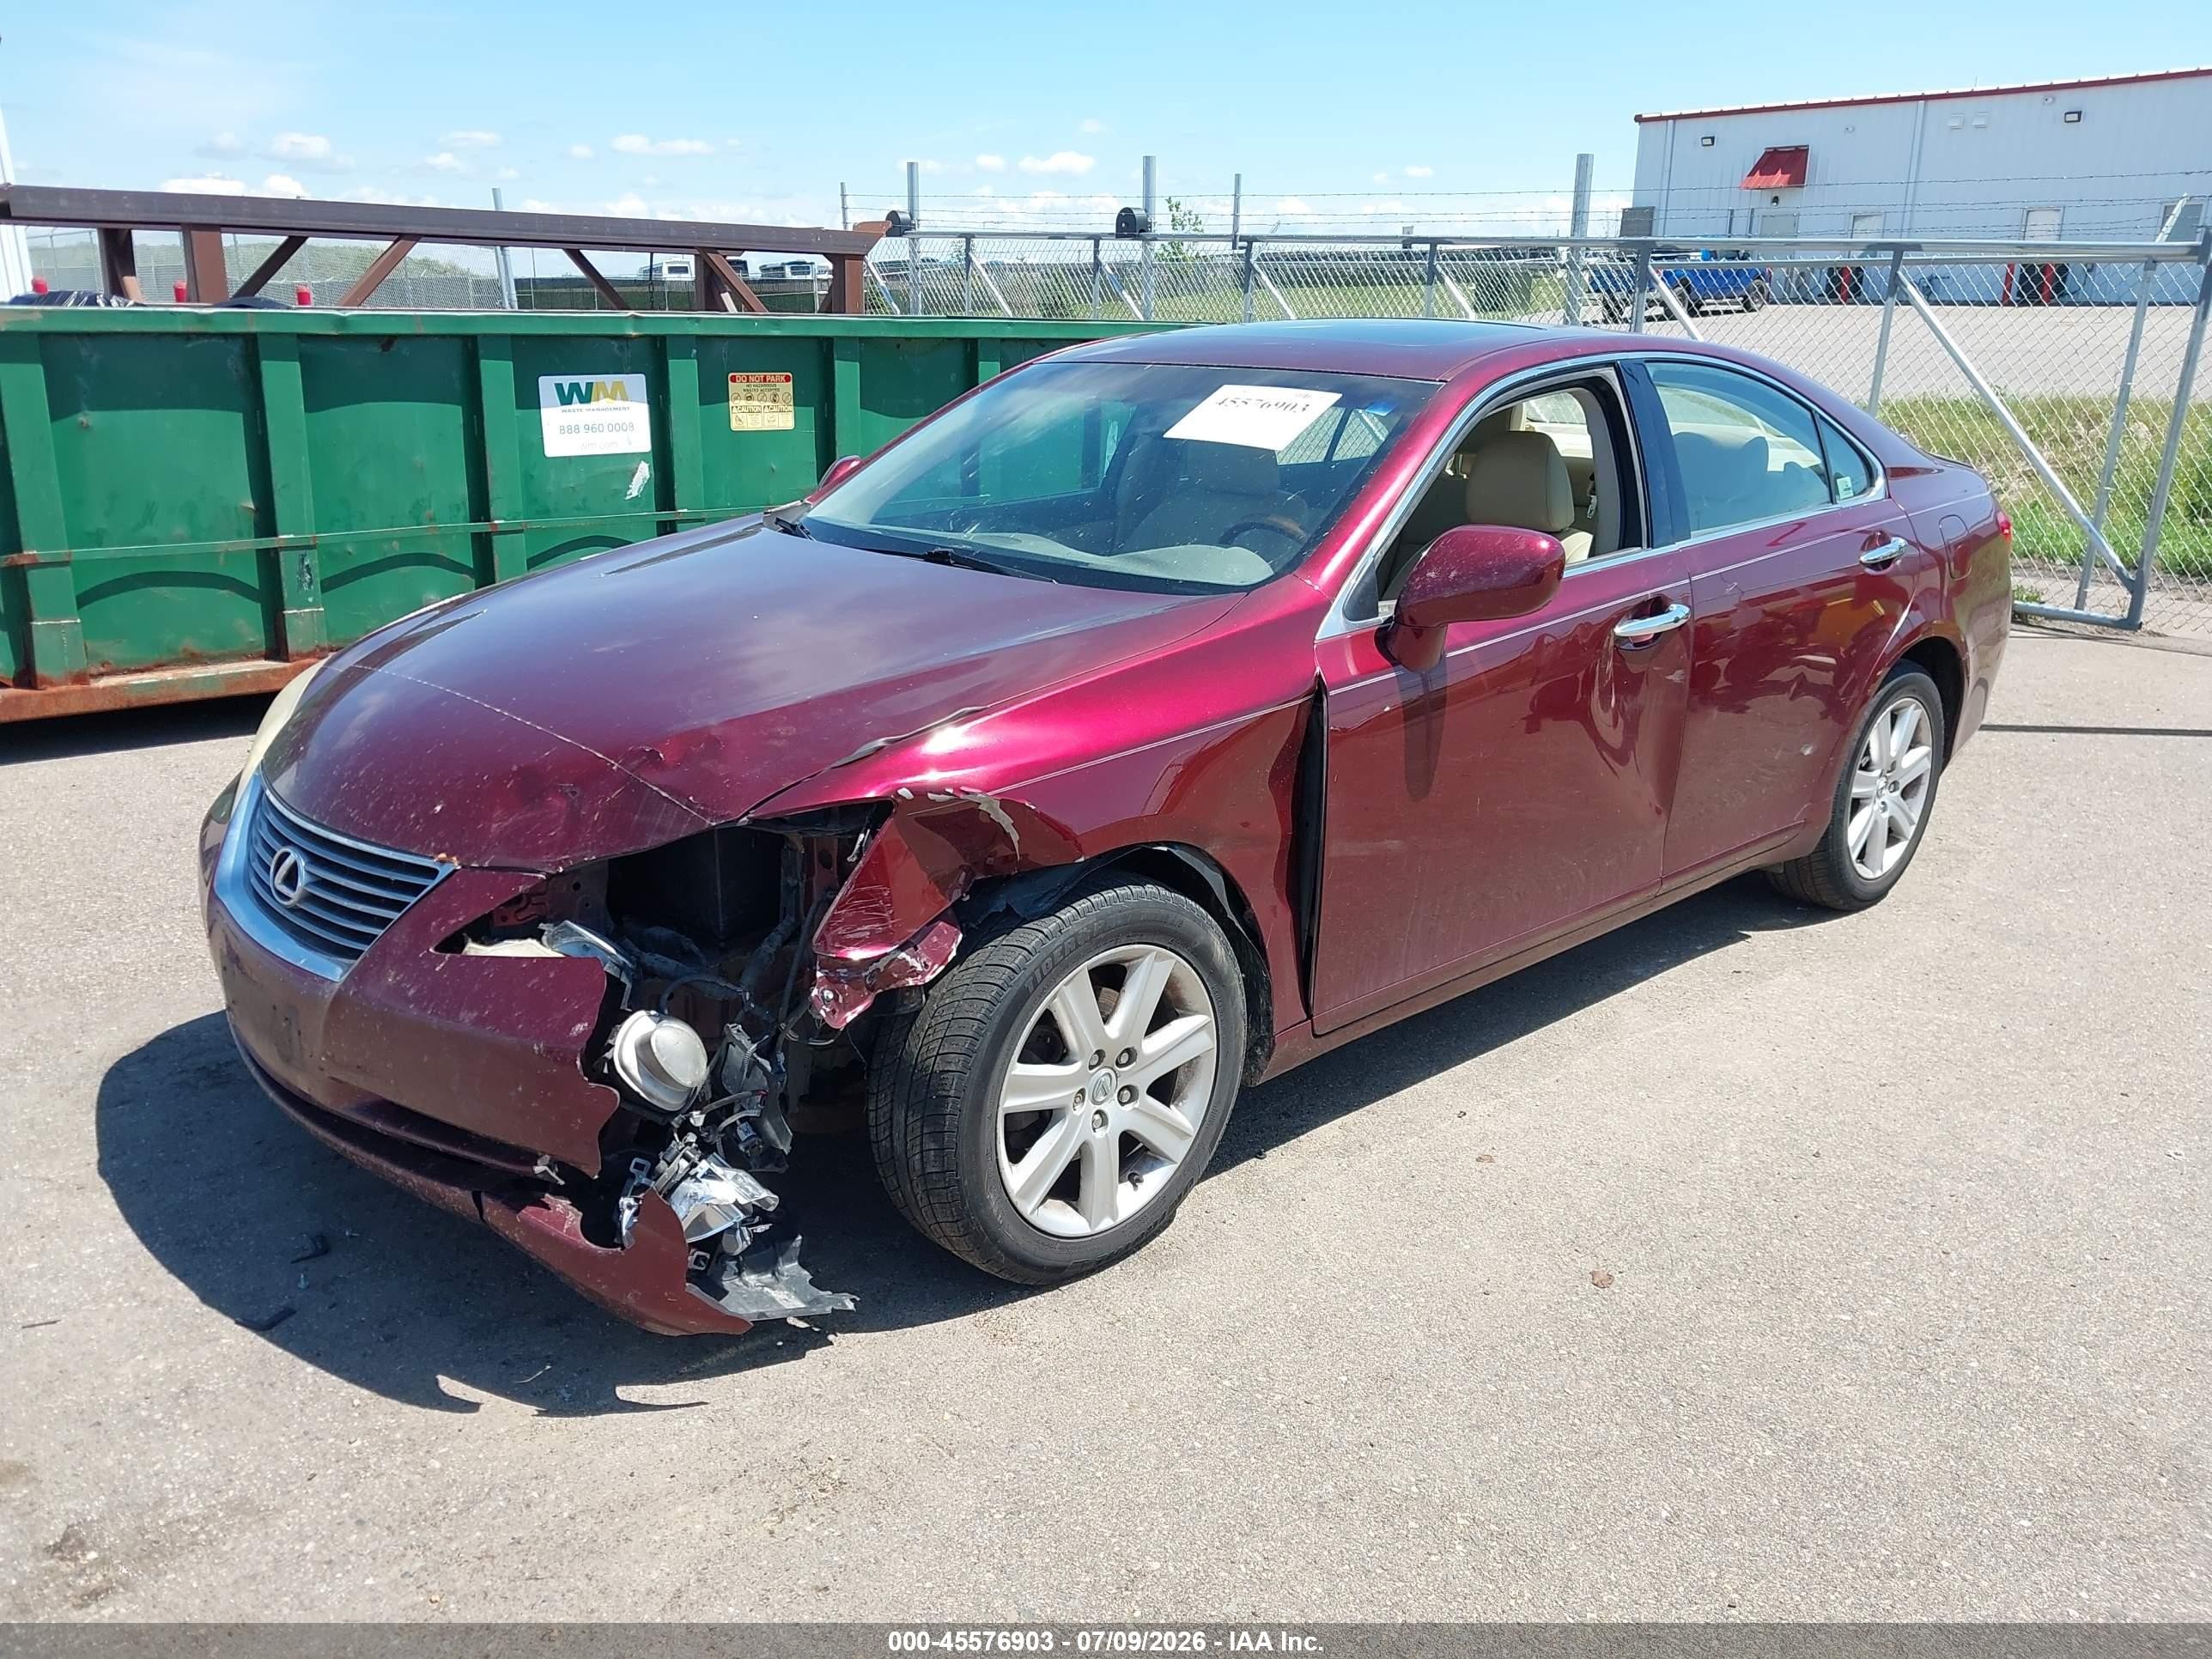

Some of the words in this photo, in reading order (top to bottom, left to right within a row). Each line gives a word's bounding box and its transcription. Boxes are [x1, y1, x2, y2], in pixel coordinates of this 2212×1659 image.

[554, 380, 629, 406] WM
[559, 424, 580, 434] 888
[584, 423, 605, 434] 960
[607, 422, 635, 432] 0008
